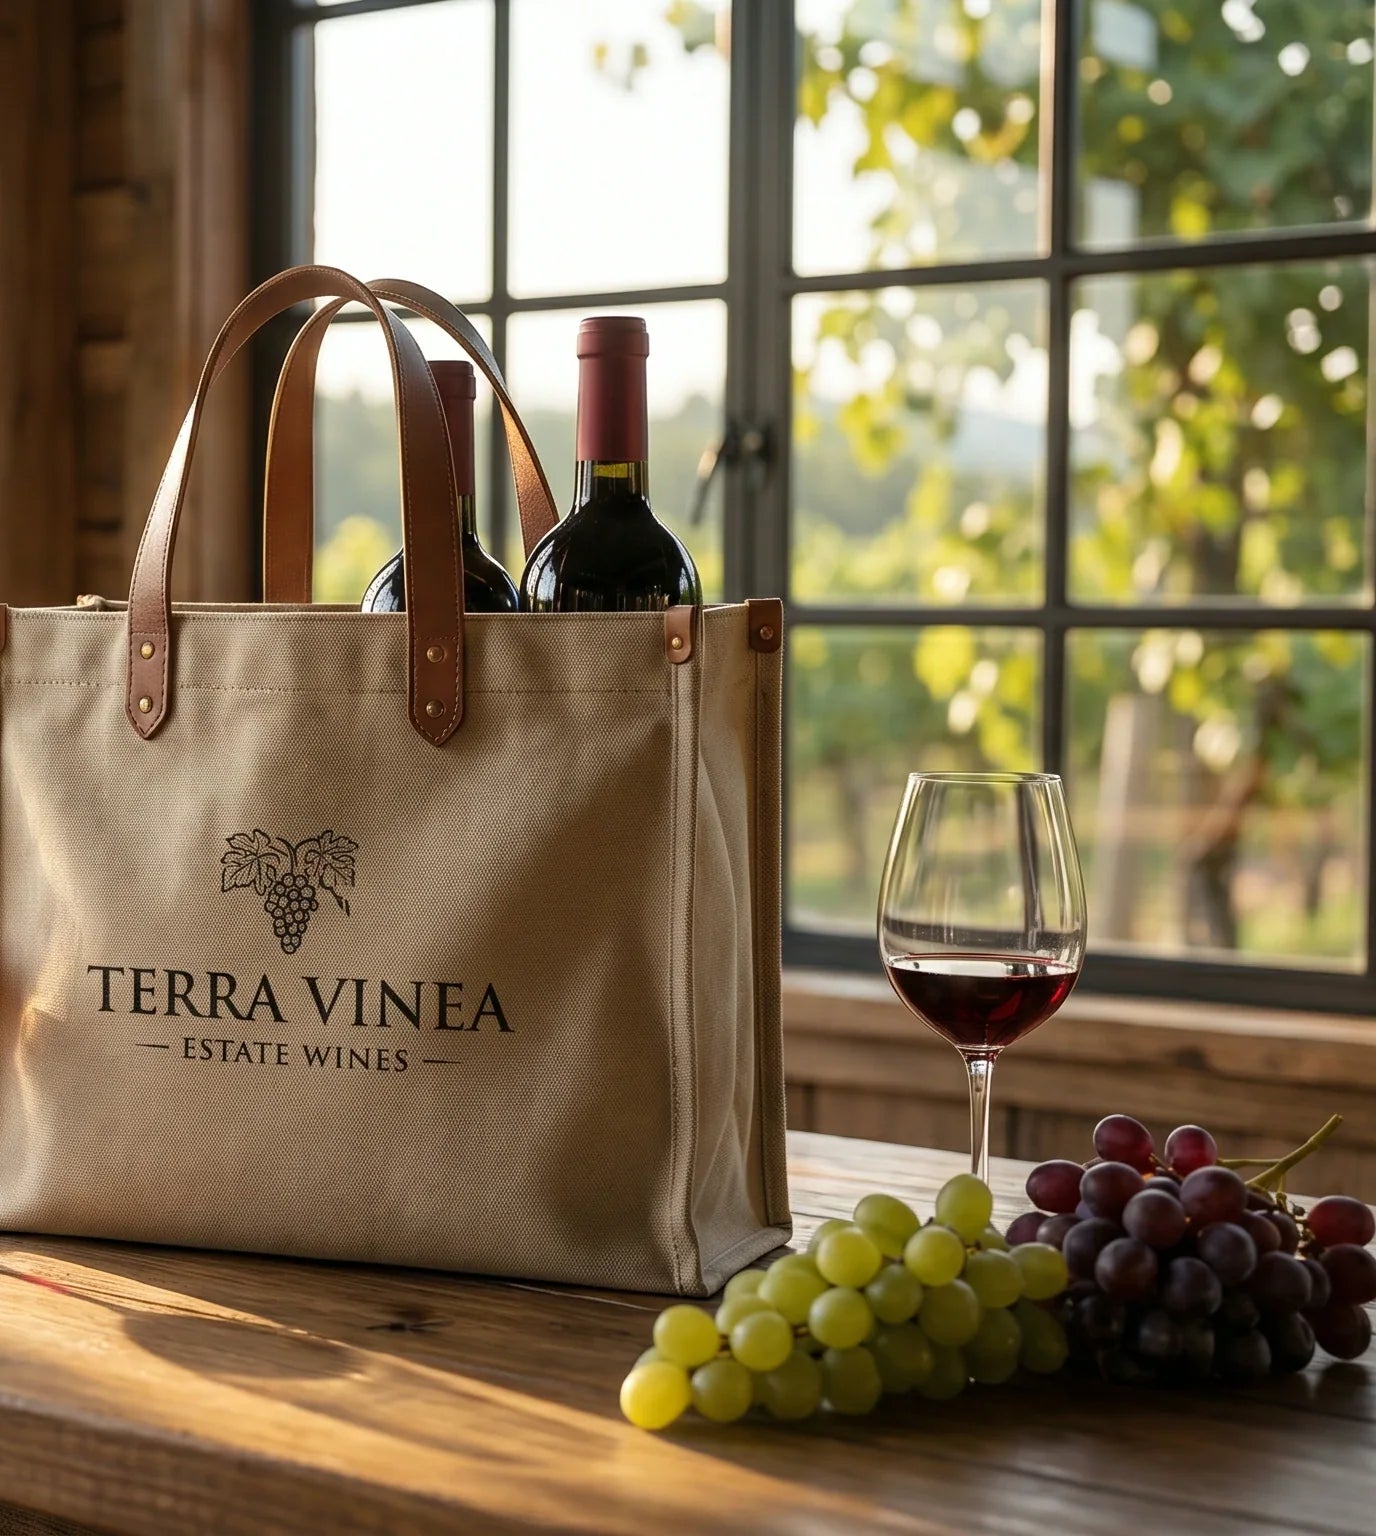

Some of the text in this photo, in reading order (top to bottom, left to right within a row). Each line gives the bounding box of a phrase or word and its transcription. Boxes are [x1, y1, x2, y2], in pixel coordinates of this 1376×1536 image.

[87, 965, 515, 1033] TERRA VINEA
[182, 1037, 409, 1073] ESTATE WINES
